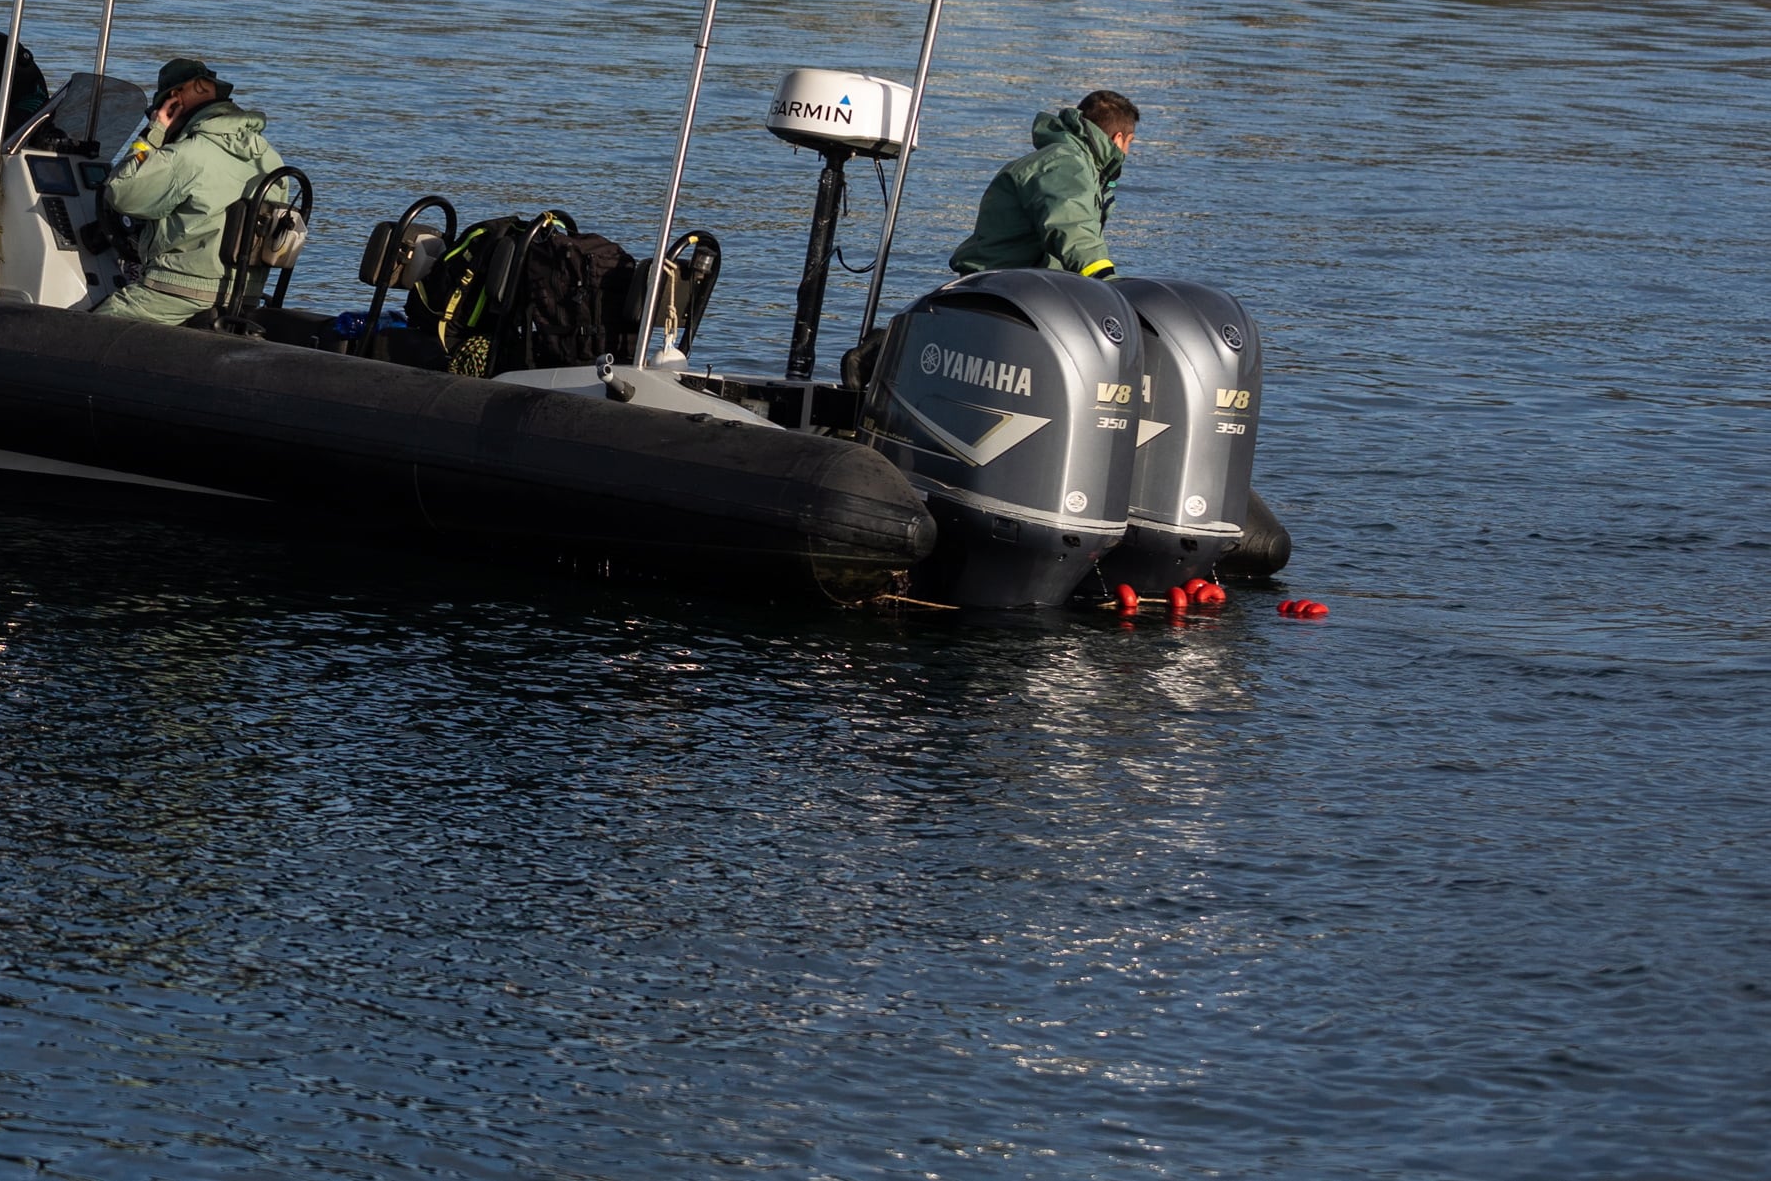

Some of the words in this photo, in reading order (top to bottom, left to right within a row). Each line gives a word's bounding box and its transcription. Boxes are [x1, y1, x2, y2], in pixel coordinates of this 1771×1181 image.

[770, 100, 853, 125] GARMIN
[942, 348, 1032, 397] YAMAHA
[1096, 382, 1132, 404] V8
[1215, 388, 1251, 410] V8
[1096, 417, 1128, 430] 350
[1215, 422, 1246, 435] 350
